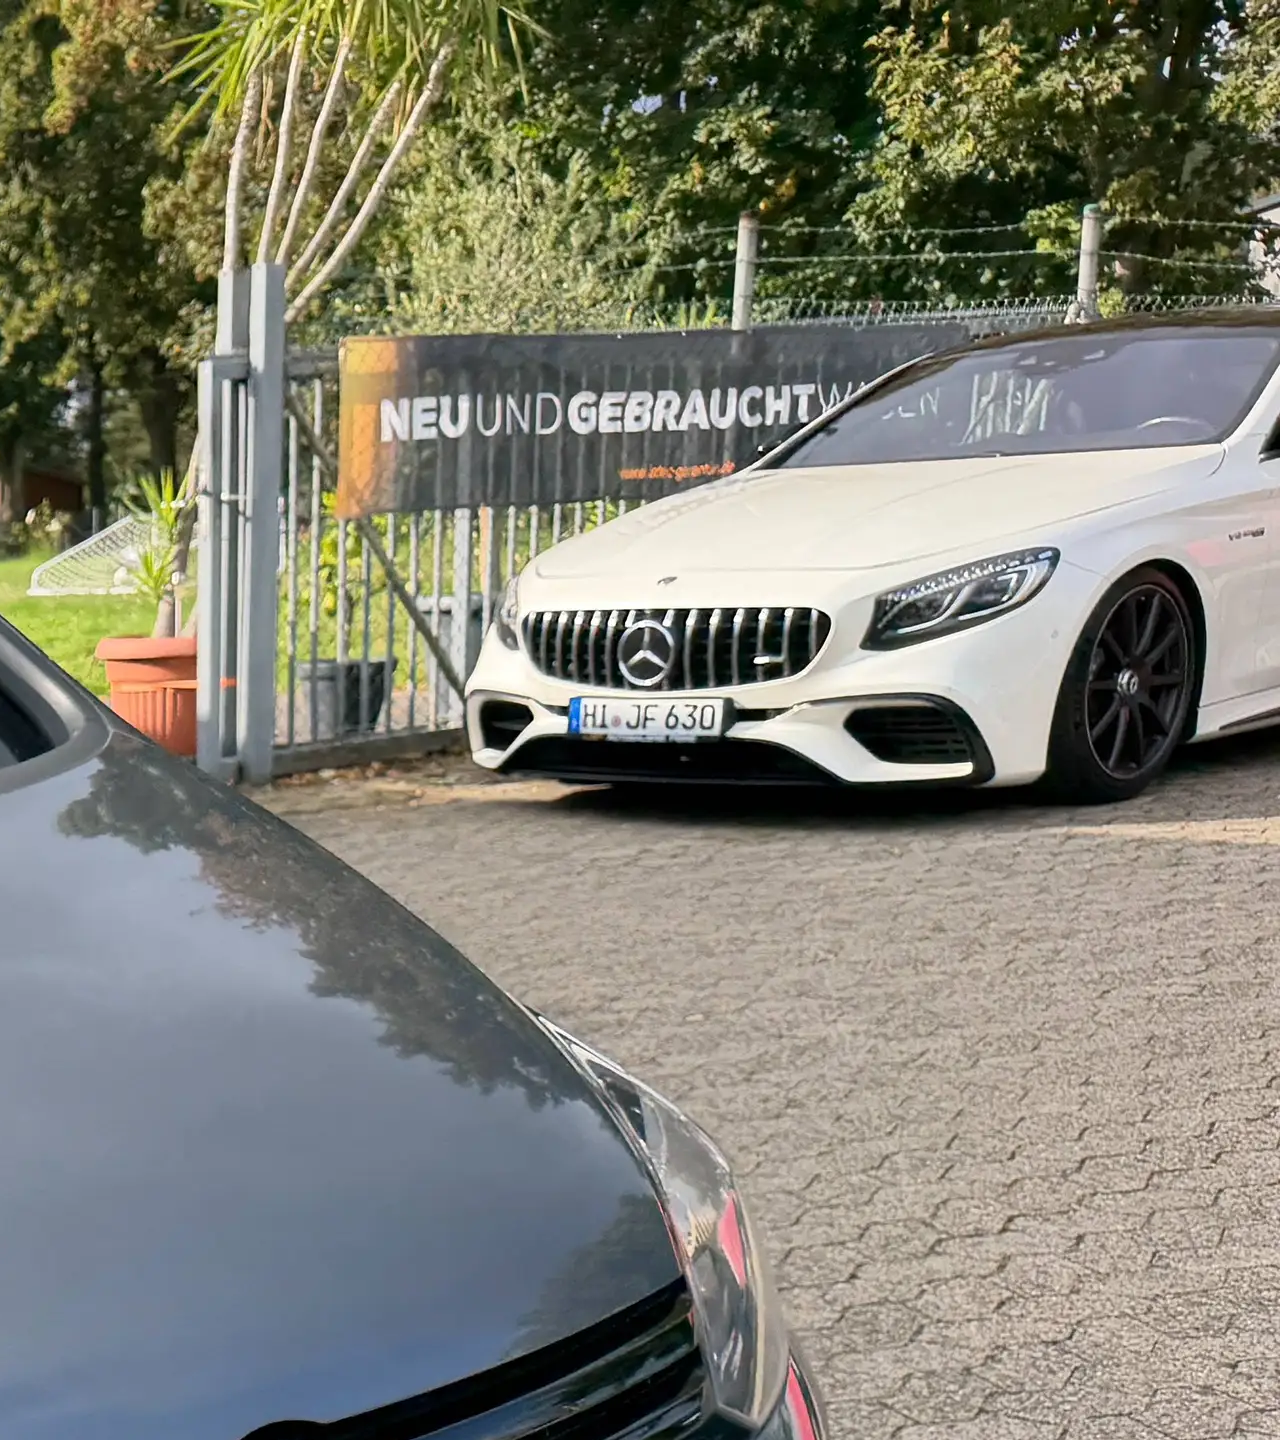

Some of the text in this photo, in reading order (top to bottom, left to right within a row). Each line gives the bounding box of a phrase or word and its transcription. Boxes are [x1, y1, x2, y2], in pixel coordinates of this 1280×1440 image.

[582, 704, 716, 730] HI JF 630
